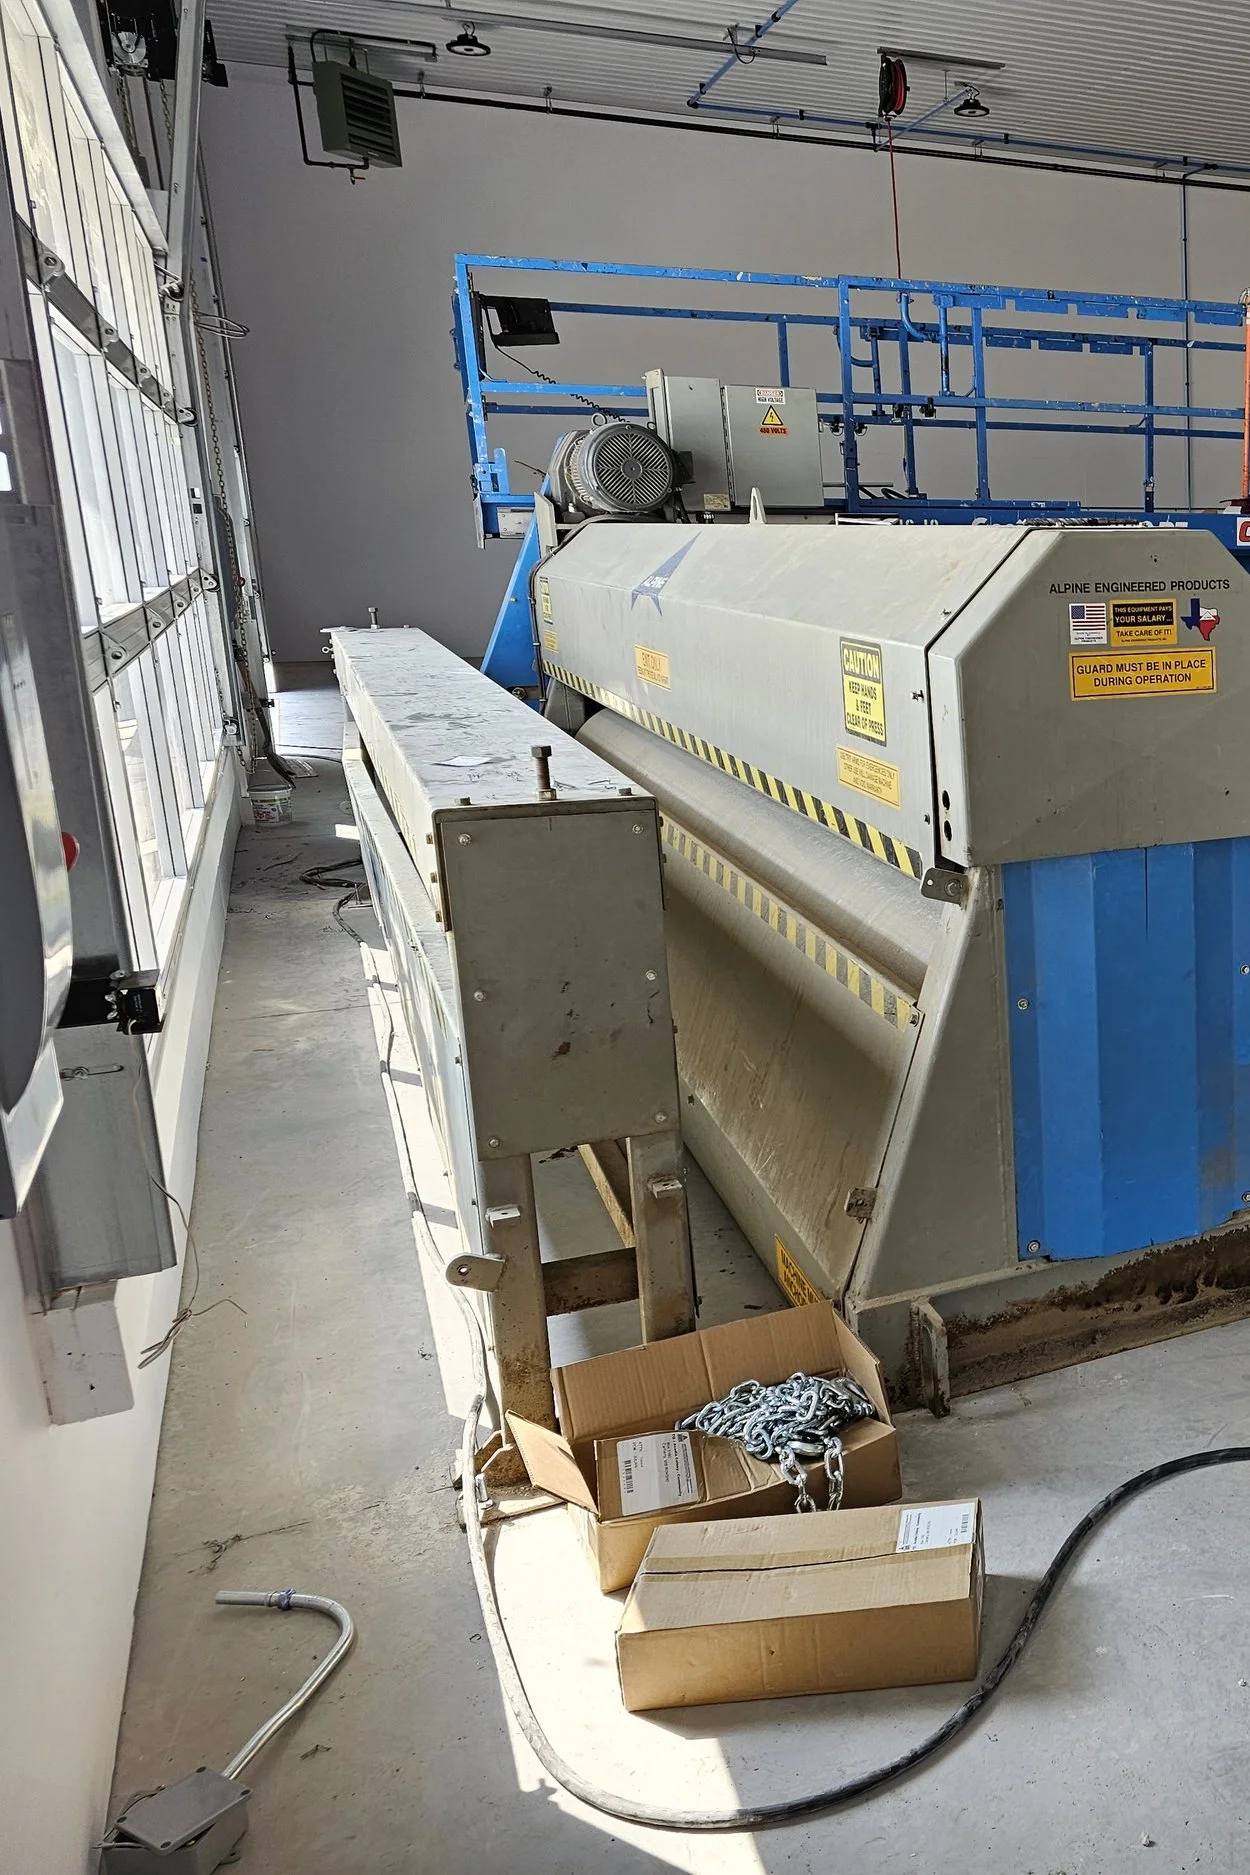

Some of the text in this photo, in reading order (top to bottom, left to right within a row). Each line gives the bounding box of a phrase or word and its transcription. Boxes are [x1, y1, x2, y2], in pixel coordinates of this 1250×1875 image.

[1049, 579, 1230, 594] ALPINE ENGINEERED PRODUCTS
[1115, 615, 1136, 623] YOUR
[1134, 629, 1153, 637] CARE
[843, 648, 880, 679] CAUTION
[1076, 659, 1206, 675] GUARD MUST BE IN PLACE
[1094, 673, 1192, 687] DURING OPERATION
[848, 680, 877, 701] KEEP HANDS
[860, 700, 872, 715] FEET
[846, 711, 884, 736] CLEAR OF PRESS
